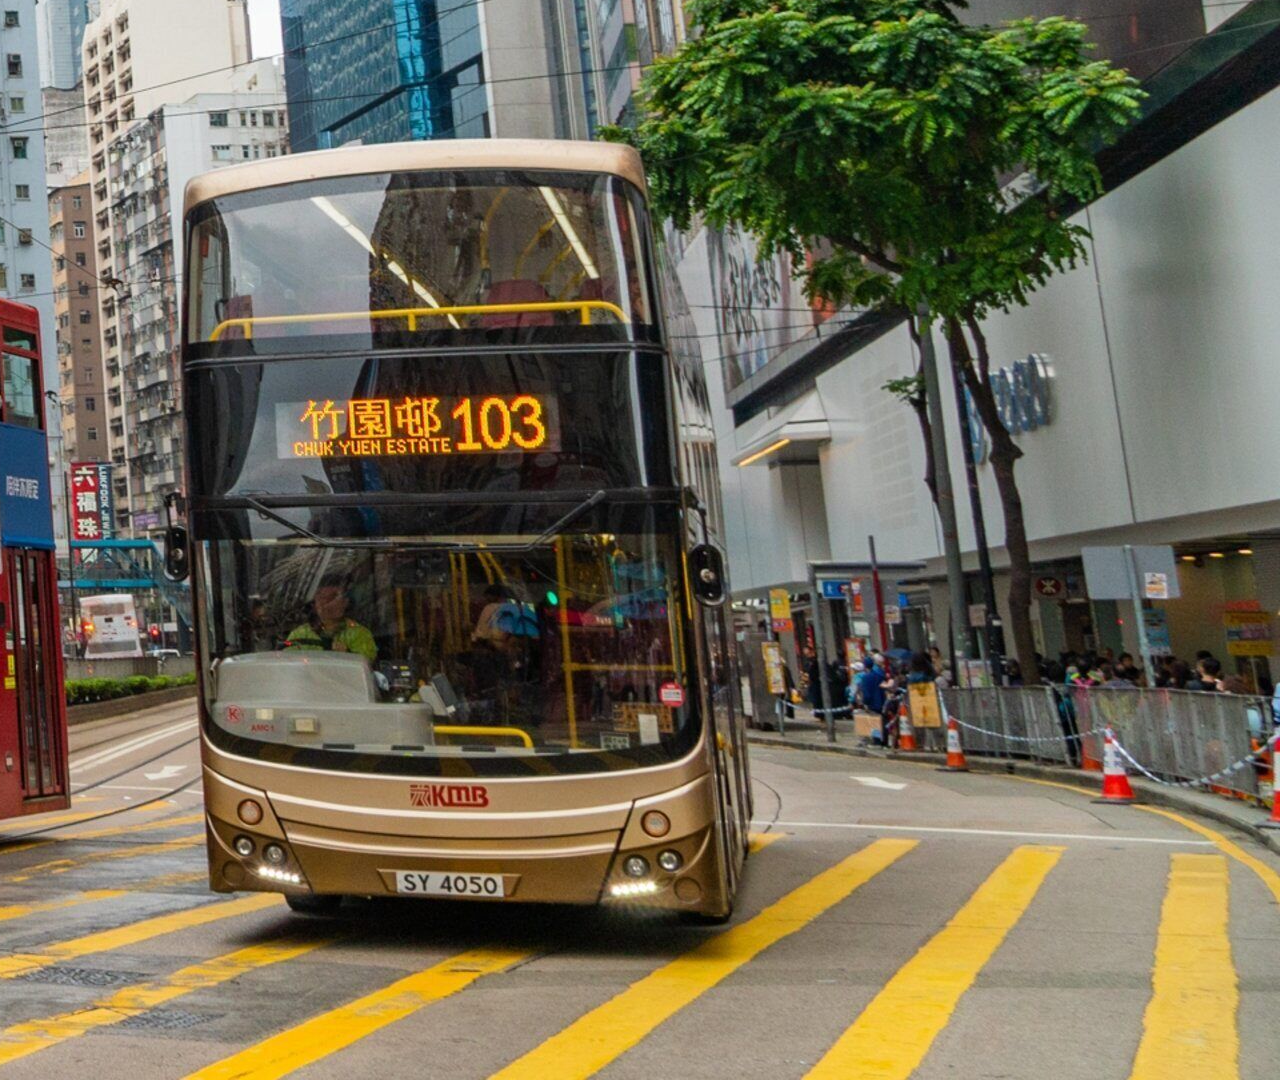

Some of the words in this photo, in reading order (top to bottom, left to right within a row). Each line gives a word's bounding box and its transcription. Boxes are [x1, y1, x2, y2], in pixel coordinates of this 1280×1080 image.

[300, 397, 442, 440] 竹園邨
[452, 395, 546, 451] 103
[294, 441, 334, 456] CHUK
[339, 440, 382, 455] YUEN
[386, 437, 452, 454] ESTATE
[98, 466, 109, 509] LUKFOOK
[431, 784, 489, 808] KMB
[403, 873, 430, 892] SY
[440, 875, 498, 895] 4050
